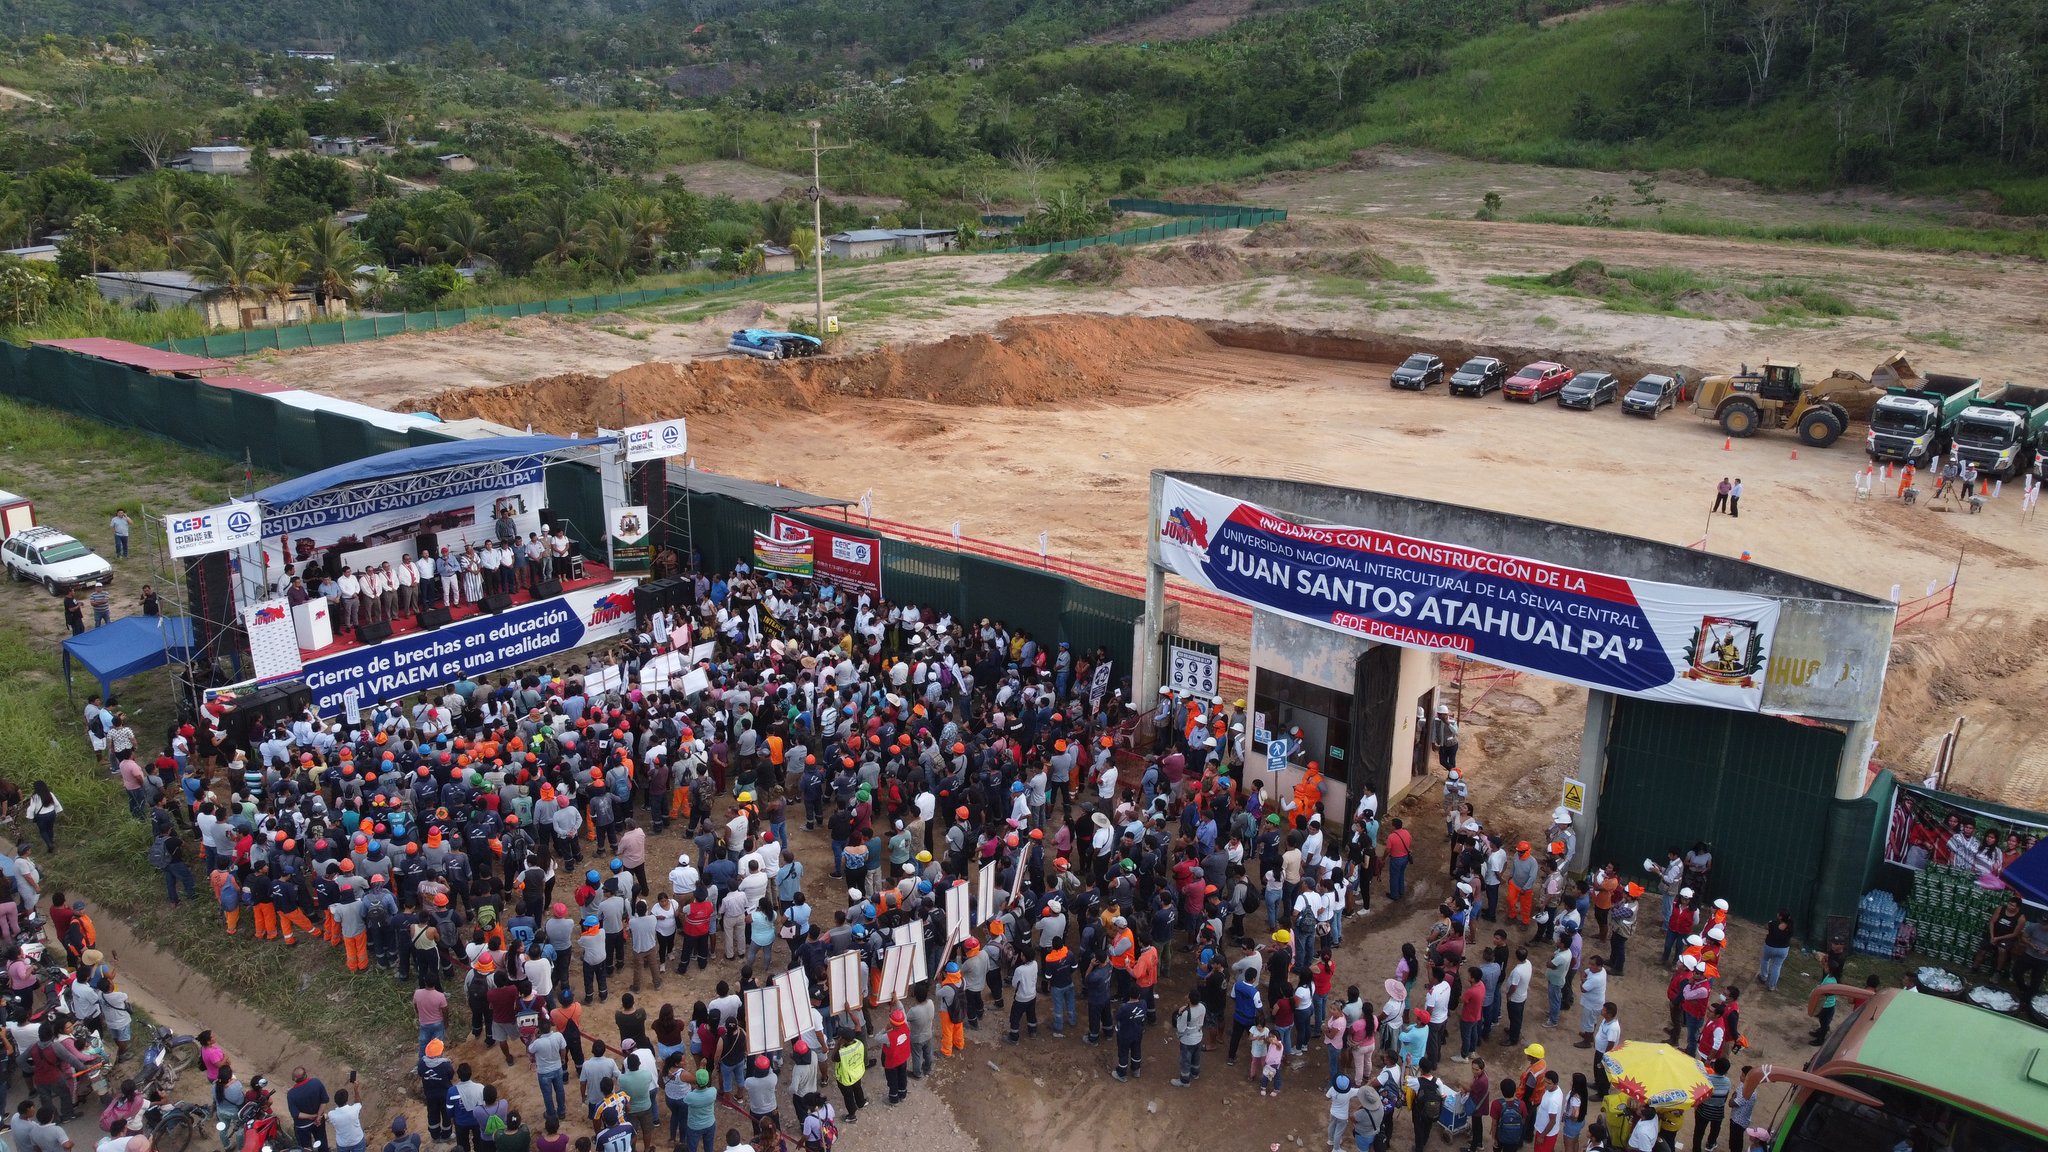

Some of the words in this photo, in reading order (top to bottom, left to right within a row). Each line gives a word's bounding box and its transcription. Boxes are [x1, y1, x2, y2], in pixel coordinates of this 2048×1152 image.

[380, 488, 443, 511] SANTOS
[1223, 527, 1294, 558] UNIVERSIDAD
[1296, 549, 1361, 573] NACIONAL
[1364, 561, 1472, 594] INTERCULTURAL
[1475, 582, 1496, 598] DE
[1500, 587, 1516, 603] LA
[1519, 592, 1564, 614] SELVA
[1567, 603, 1640, 630] CENTRAL
[1259, 516, 1333, 543] INICIAMOS
[1336, 532, 1372, 550] CON
[1375, 537, 1394, 555] LA
[1397, 542, 1531, 580] CONSTRUCCIÓN
[1535, 568, 1560, 587] DE
[1564, 575, 1587, 592] LA
[1296, 569, 1415, 618] SANTOS
[305, 665, 364, 690] Cierre
[368, 656, 390, 674] de
[394, 638, 461, 667] brechas
[464, 633, 485, 648] en
[489, 609, 568, 642] educación
[1333, 612, 1368, 633] SEDE
[1370, 621, 1469, 652] PICHANAQUI
[319, 692, 343, 709] en
[367, 663, 438, 695] VRAEM
[442, 659, 461, 675] es
[464, 650, 495, 669] una
[498, 628, 560, 660] realidad
[515, 929, 528, 941] 19
